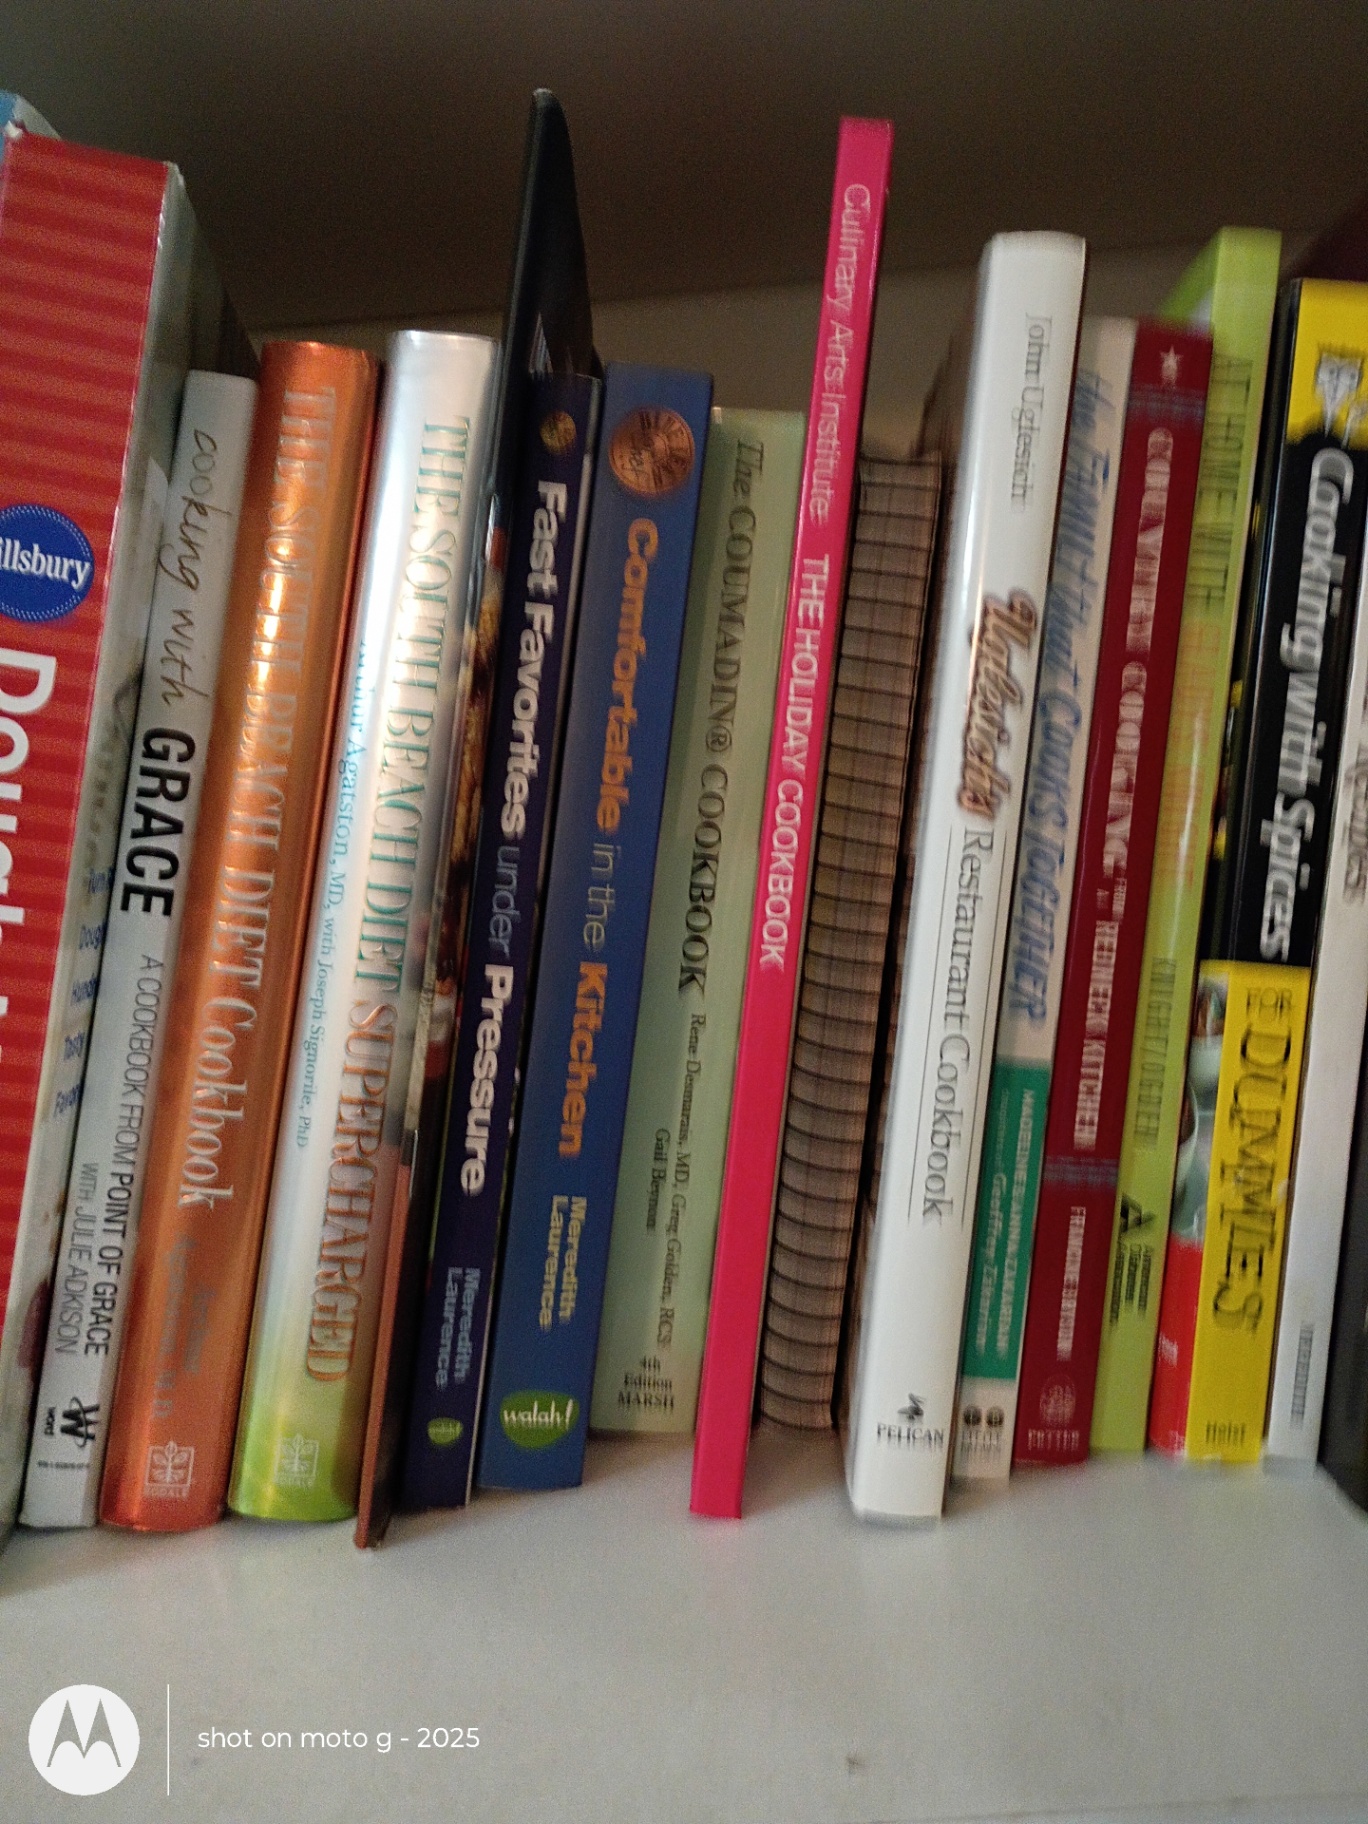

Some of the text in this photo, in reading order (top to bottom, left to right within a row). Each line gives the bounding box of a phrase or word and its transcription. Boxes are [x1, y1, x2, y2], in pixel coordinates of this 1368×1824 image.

[809, 184, 871, 529] Culinary Arts Institute
[1025, 313, 1052, 377] John
[274, 385, 335, 487] THE
[162, 610, 210, 706] with
[597, 518, 658, 835] Comfortable
[678, 439, 764, 999] The COUMADIN® COOKBOOK
[1260, 447, 1353, 962] Cooking with Spices
[120, 727, 195, 917] GRACE
[225, 684, 300, 851] BEACH
[331, 738, 367, 866] Agatston,
[759, 554, 829, 974] THE HOLIDAY COOKBOOK
[1103, 661, 1147, 879] COOKING
[306, 415, 470, 1382] THE SOUTH BEACH DIET SUPERCHARGED
[326, 872, 346, 911] MD,
[460, 480, 568, 1197] Fast Favorites under Pressure
[591, 842, 621, 879] in
[208, 865, 275, 991] DIET
[321, 918, 341, 955] with
[583, 884, 615, 952] the
[944, 826, 994, 1032] Restaurant
[310, 958, 334, 1020] Joseph
[179, 997, 258, 1211] Cookbook
[301, 1022, 325, 1109] Signorile,
[559, 961, 608, 1159] Kitchen
[84, 954, 164, 1356] A COOKBOOK FROM POINT OF GRACE
[297, 1118, 312, 1149] PhD
[653, 1128, 670, 1165] Gail
[922, 1033, 971, 1228] Cookbook
[1212, 1028, 1291, 1335] DUMMIES
[55, 1163, 99, 1355] WITH JULIE ADKISON
[539, 1195, 569, 1332] Laurence
[559, 1196, 587, 1324] Meredith
[435, 1267, 462, 1391] Laurence
[455, 1268, 481, 1384] Meredith
[504, 1399, 573, 1431] walah!
[877, 1423, 944, 1450] PELICAN
